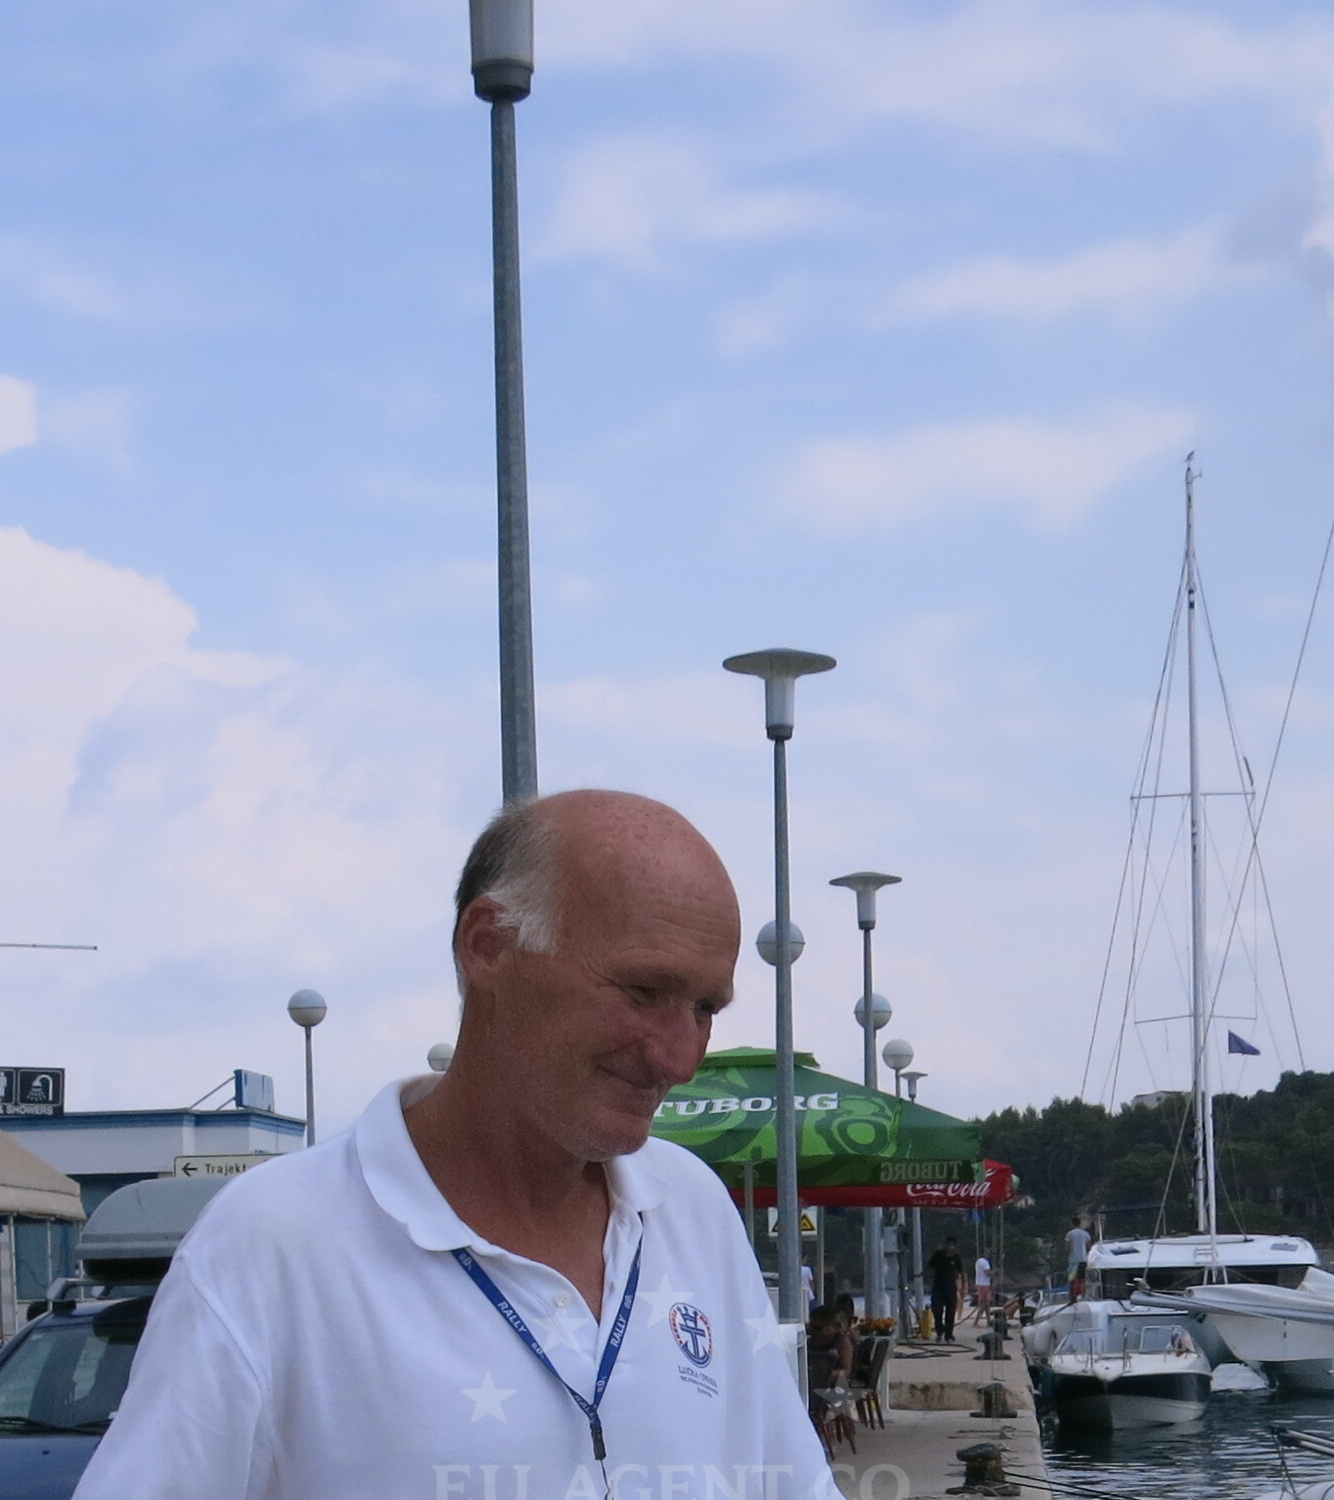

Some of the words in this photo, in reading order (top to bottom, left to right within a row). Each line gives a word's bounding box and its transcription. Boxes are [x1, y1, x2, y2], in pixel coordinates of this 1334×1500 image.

[6, 1104, 53, 1115] SHOWERS
[205, 1163, 246, 1176] Trajekt
[497, 1301, 528, 1334] RALLY
[609, 1314, 627, 1348] RALLY
